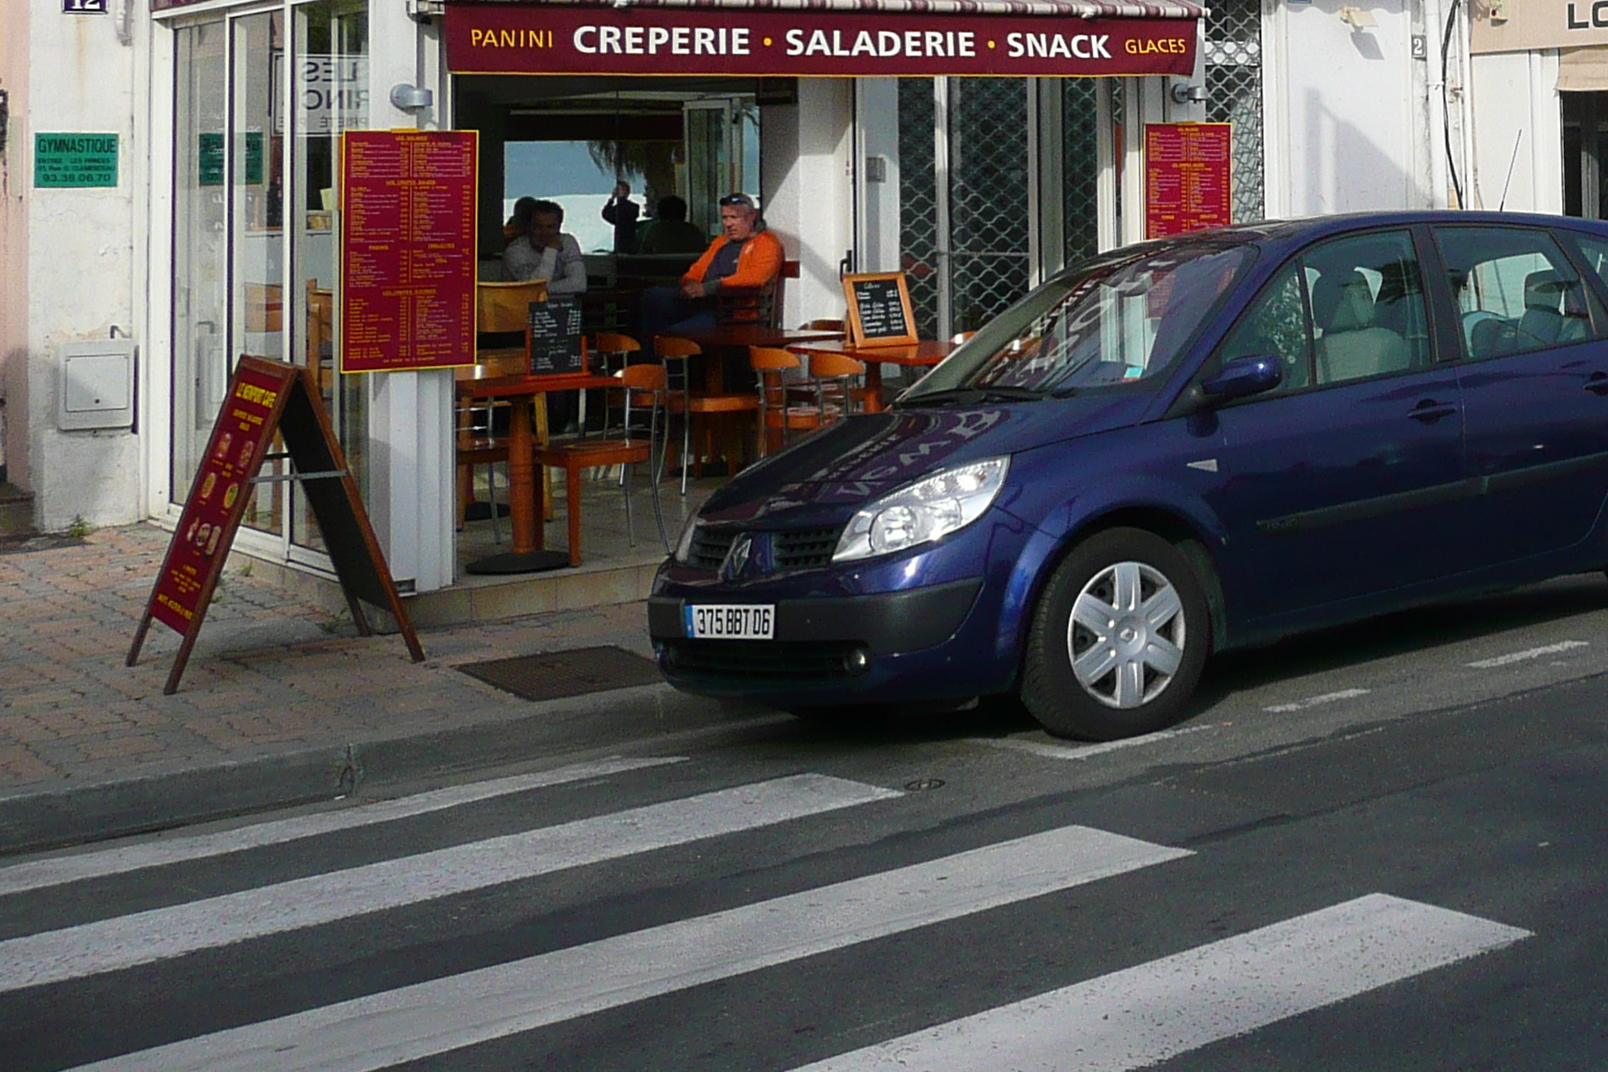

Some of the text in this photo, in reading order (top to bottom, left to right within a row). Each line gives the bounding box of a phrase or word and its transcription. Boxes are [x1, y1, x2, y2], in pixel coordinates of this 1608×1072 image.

[471, 25, 1187, 59] PANINI CREPERIE SALADERIE SNACK GLACES
[39, 138, 116, 153] GYMNASTIQUE
[697, 609, 770, 635] 375 BBT 06
